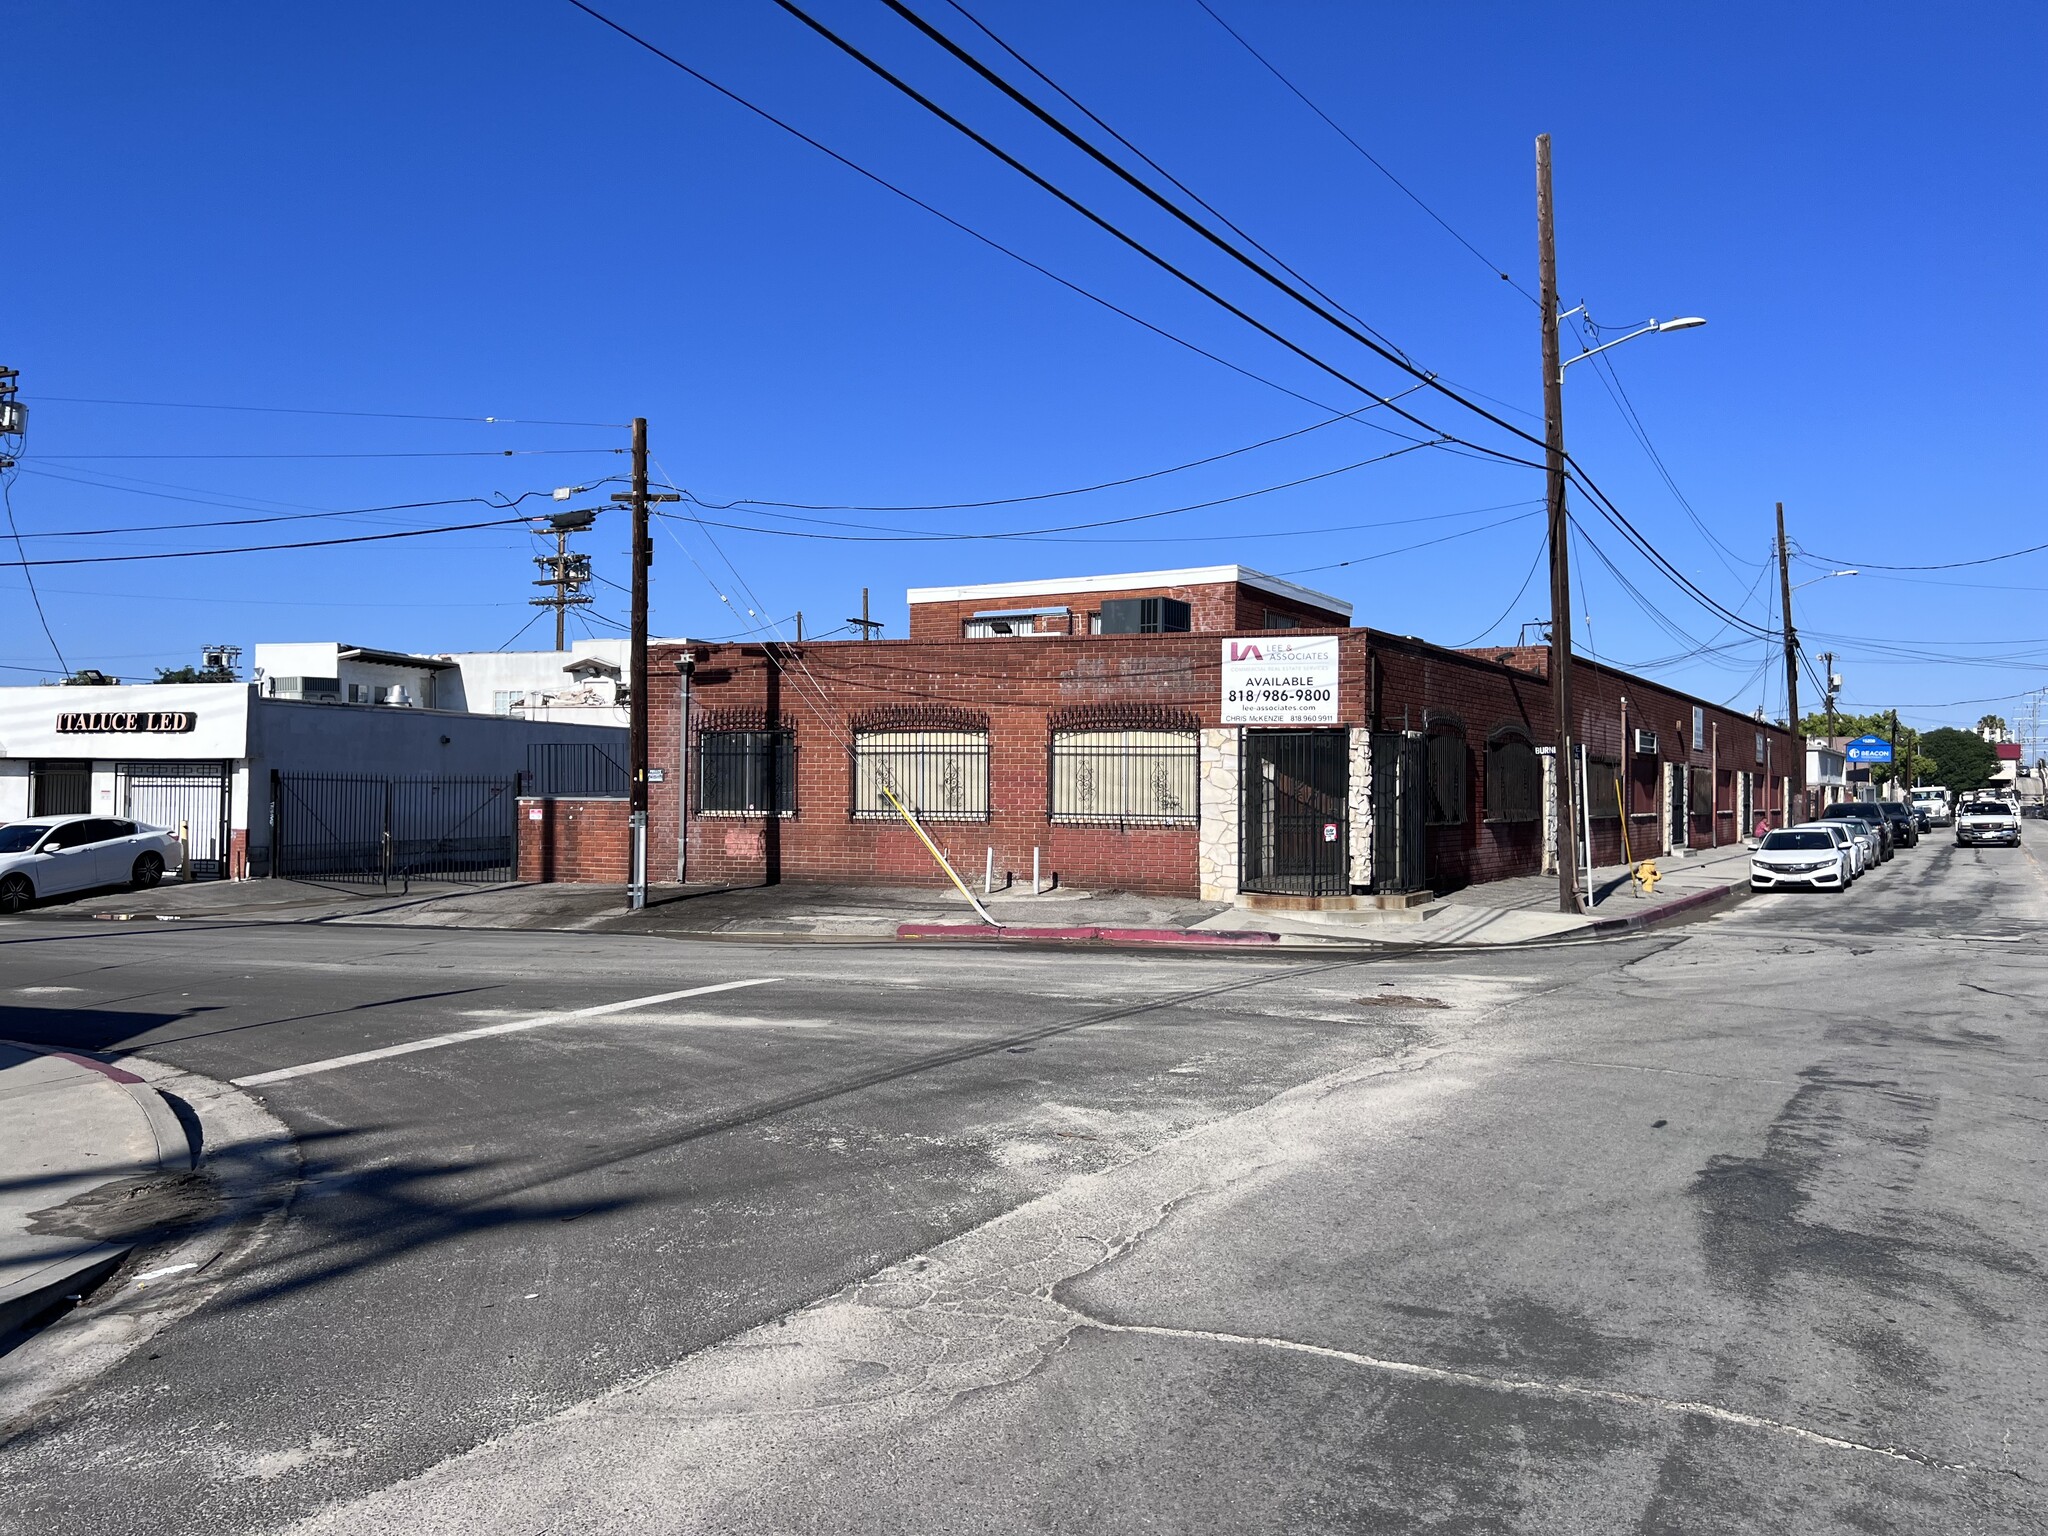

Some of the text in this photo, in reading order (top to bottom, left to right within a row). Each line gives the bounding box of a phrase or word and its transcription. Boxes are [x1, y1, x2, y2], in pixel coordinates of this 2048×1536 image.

[1266, 644, 1293, 652] LEE &
[1269, 652, 1329, 661] ASSOCIATES
[1245, 677, 1314, 686] AVAILABLE
[1228, 689, 1331, 703] 818/986-9800
[56, 712, 187, 731] ITALUCE LED
